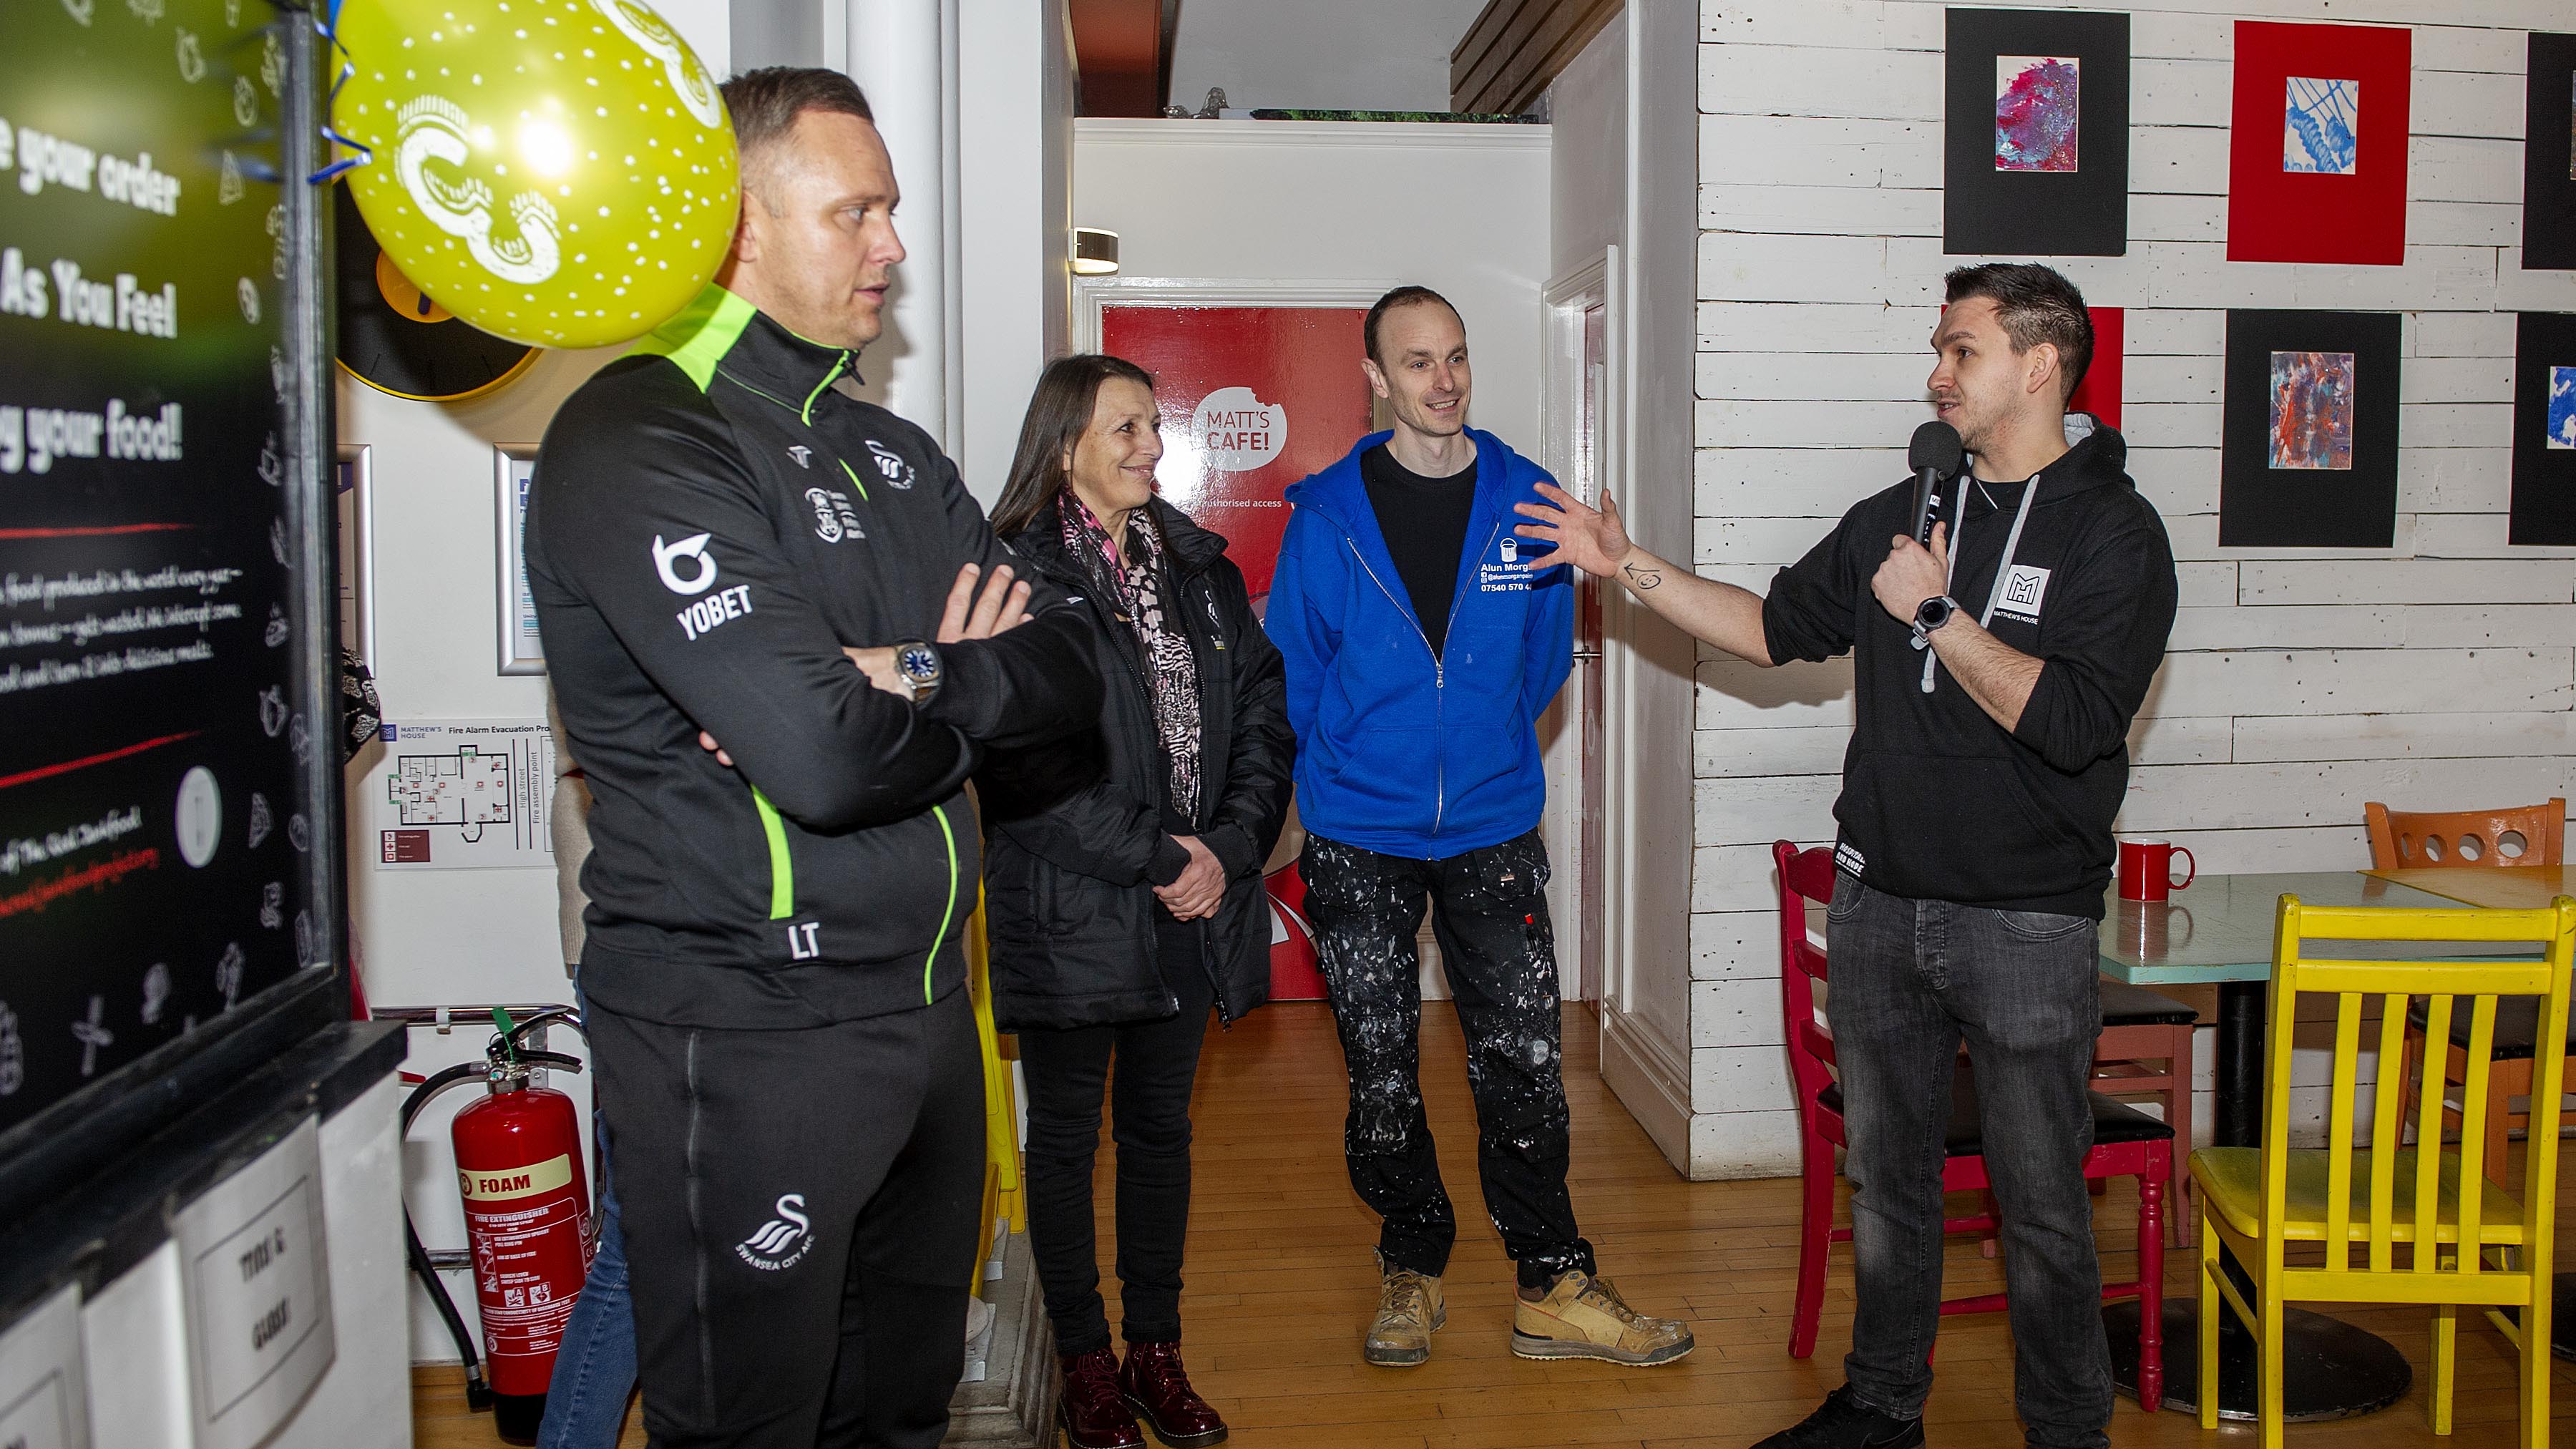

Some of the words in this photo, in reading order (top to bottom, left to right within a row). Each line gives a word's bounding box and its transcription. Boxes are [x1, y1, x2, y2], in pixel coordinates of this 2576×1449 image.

[18, 126, 96, 195] your
[98, 152, 181, 218] order
[1, 247, 49, 319] As
[51, 258, 114, 330] You
[115, 273, 177, 340] Feel
[1207, 411, 1270, 429] MATT'S
[26, 406, 104, 474] your
[107, 398, 182, 462] food!
[1207, 432, 1269, 451] CAFE!
[1504, 564, 1531, 572] Morg
[676, 585, 753, 641] YOBET
[2020, 616, 2039, 625] HOUSE
[530, 751, 540, 774] point
[519, 791, 527, 808] High
[531, 775, 540, 808] assembly
[1836, 852, 1848, 864] AND
[1846, 858, 1865, 873] HOPE
[788, 922, 820, 960] LT
[479, 1174, 531, 1193] FOAM
[489, 1207, 550, 1223] EXTINGUISHER
[736, 1243, 781, 1271] SWANSEA
[781, 1252, 802, 1269] CITY
[801, 1234, 816, 1254] AFC
